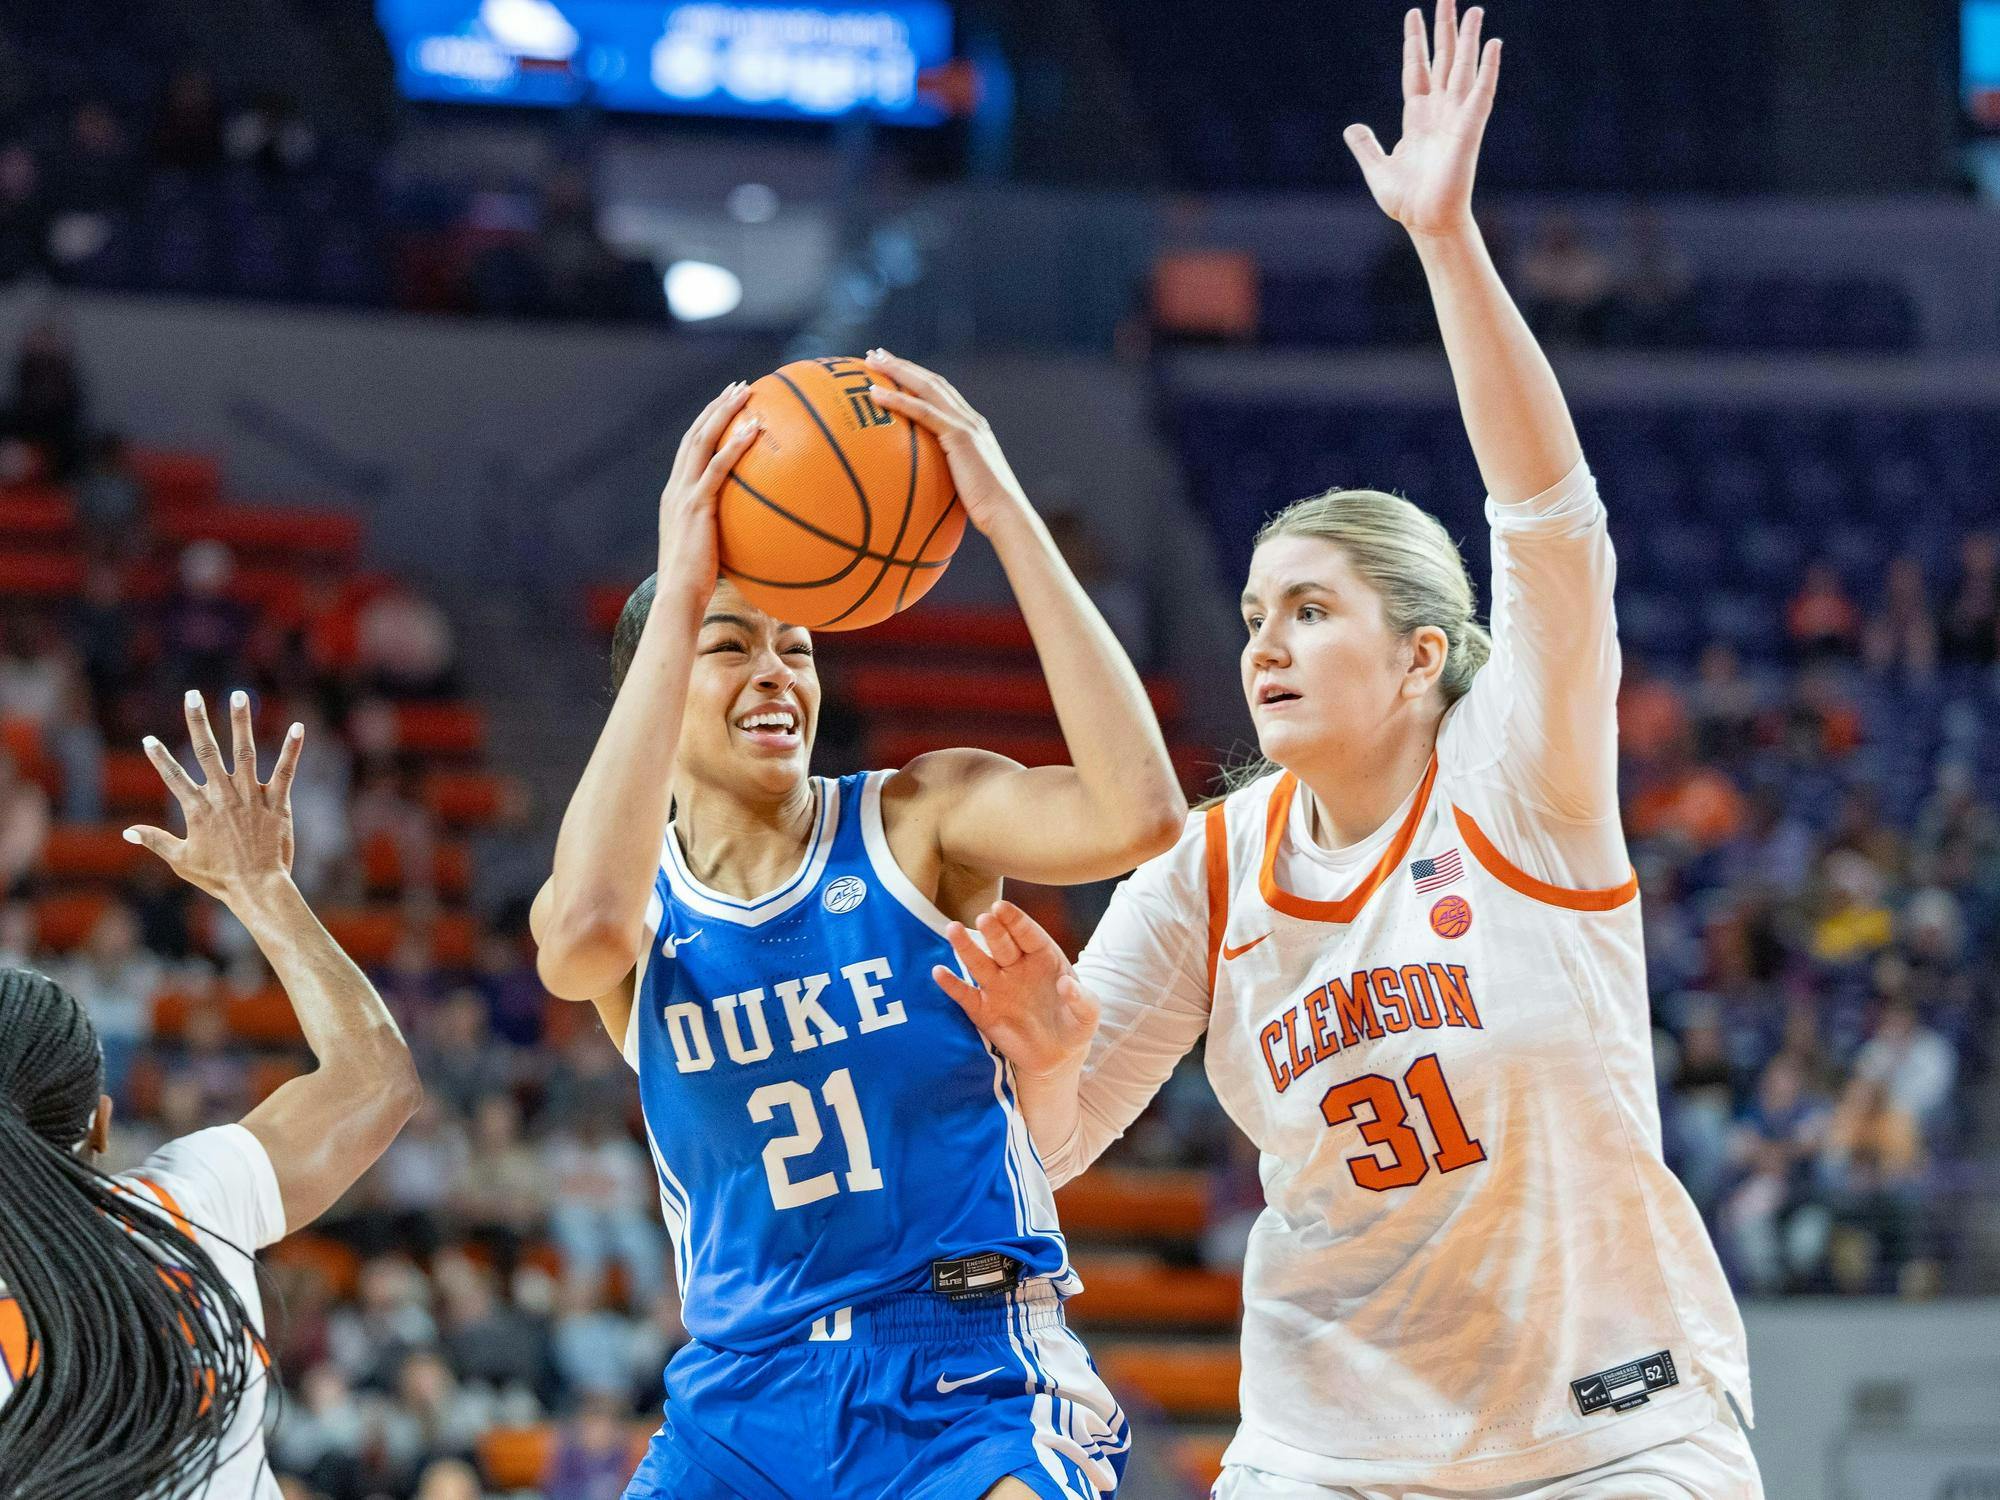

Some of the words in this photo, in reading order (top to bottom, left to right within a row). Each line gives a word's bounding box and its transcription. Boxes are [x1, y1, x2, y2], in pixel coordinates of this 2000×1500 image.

[816, 358, 895, 429] LITE
[830, 880, 861, 905] ACC
[664, 956, 908, 1074] DUKE
[1259, 963, 1485, 1094] CLEMSON
[746, 1067, 884, 1211] 21
[1319, 1053, 1488, 1192] 31
[1583, 1393, 1608, 1405] TEAM
[1644, 1365, 1663, 1381] 52
